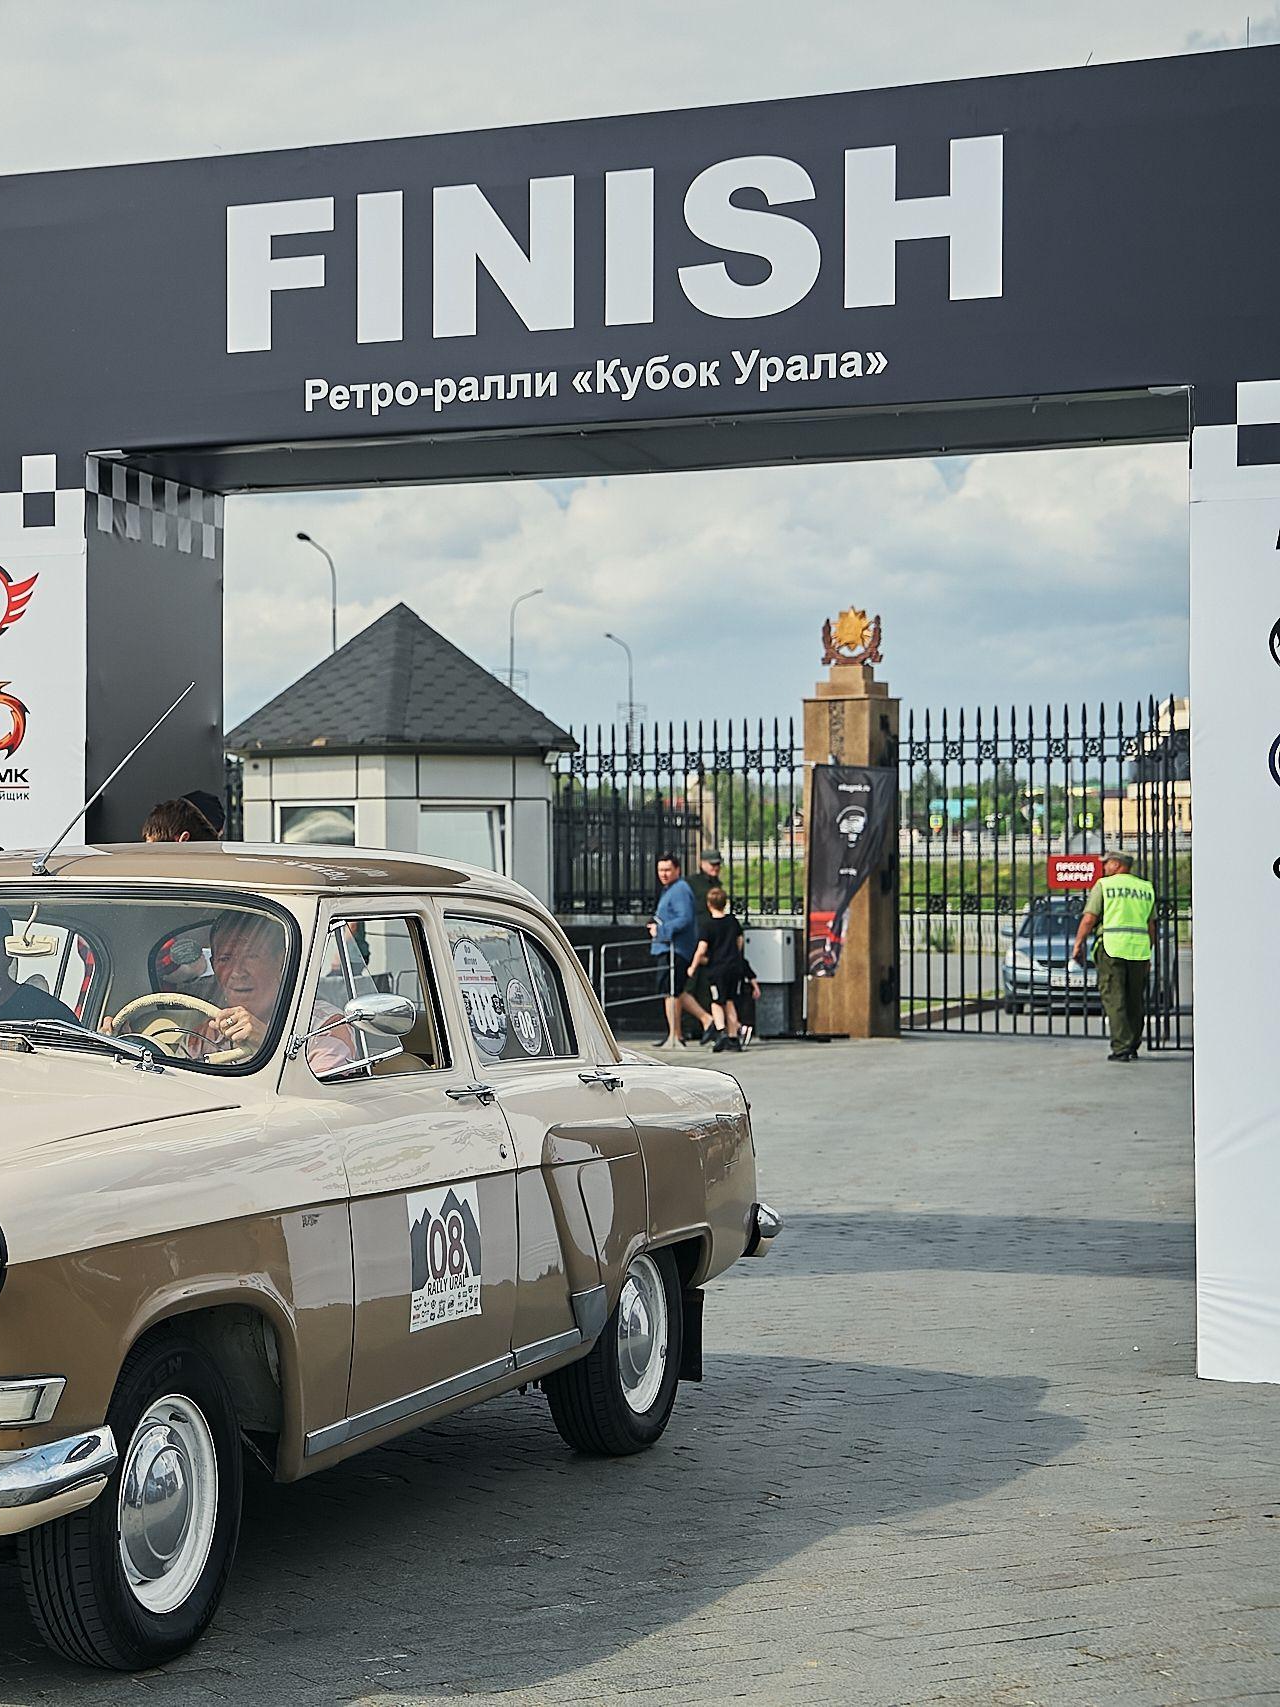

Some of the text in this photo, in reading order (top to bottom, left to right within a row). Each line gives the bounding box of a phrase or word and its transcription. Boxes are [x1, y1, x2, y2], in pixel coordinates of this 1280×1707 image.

[226, 134, 1004, 354] FINISH
[304, 348, 889, 416] Ретро-ралли «Кубок Урала»
[1055, 861, 1095, 873] ПРОХОД
[1056, 872, 1094, 882] ЗАКРЫТ
[1106, 886, 1152, 900] ОХРАНА
[429, 1215, 465, 1281] 08
[427, 1273, 467, 1297] RALLY URAL
